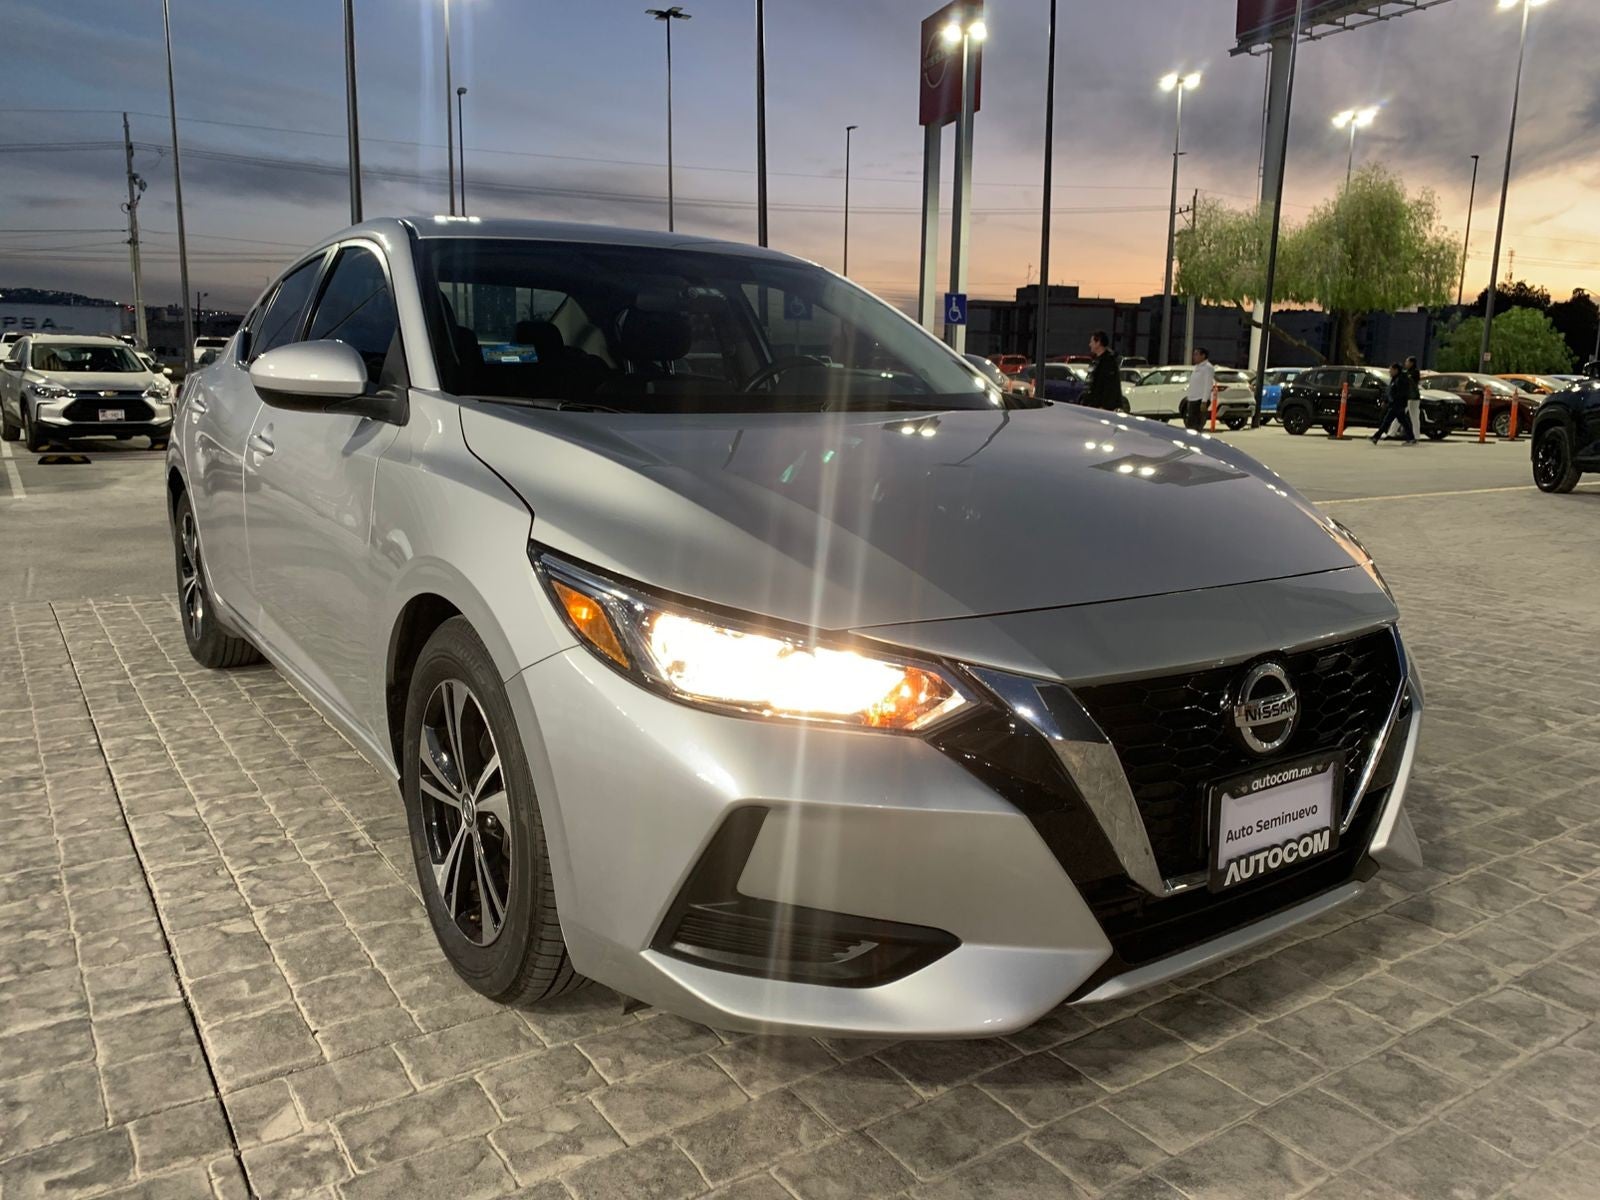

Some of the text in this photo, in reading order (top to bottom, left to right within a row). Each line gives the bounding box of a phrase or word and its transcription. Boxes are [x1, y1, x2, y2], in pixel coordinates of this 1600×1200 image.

[1244, 698, 1297, 722] NISSAN
[1251, 766, 1313, 791] autocom.mx
[1225, 804, 1318, 844] Auto Seminuevo
[1223, 829, 1330, 887] AUTOCOM
